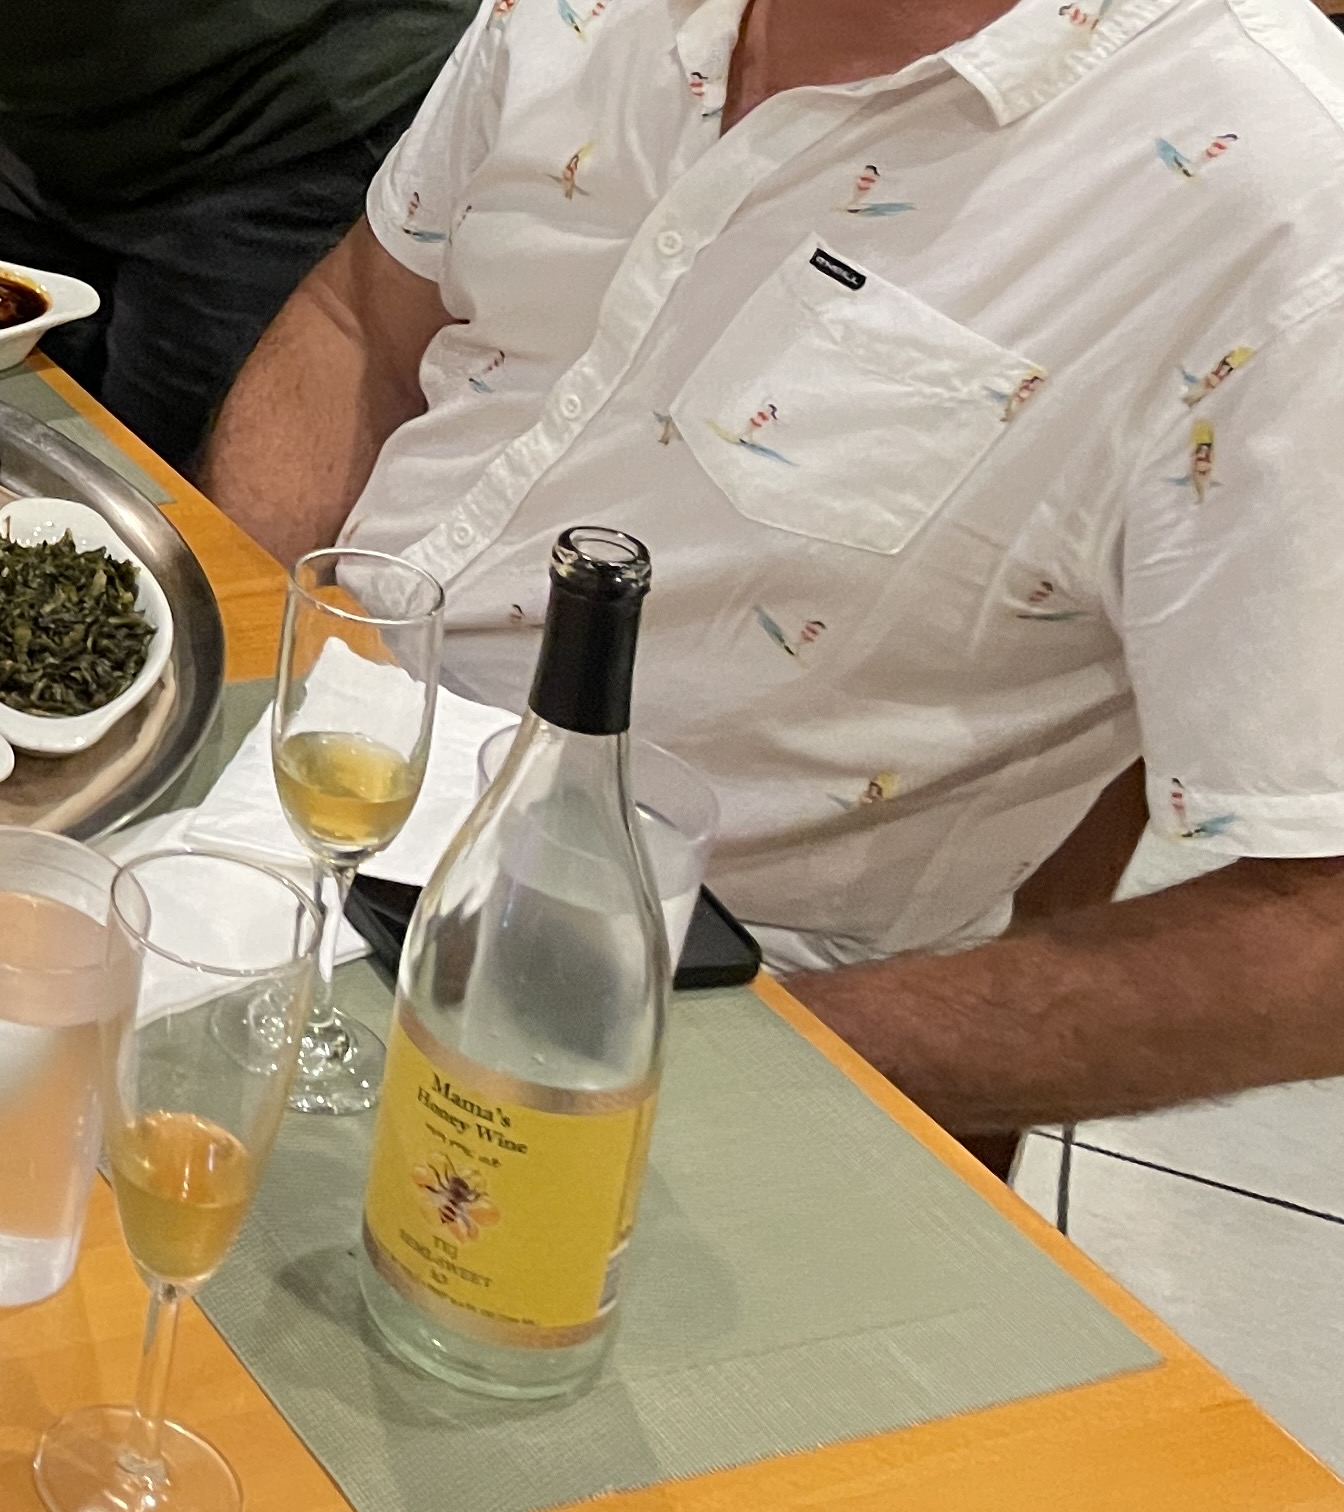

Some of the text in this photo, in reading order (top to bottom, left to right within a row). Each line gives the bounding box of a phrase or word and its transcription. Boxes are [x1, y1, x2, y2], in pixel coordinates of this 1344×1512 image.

[418, 1085, 471, 1134] Honey
[476, 1123, 528, 1154] Wine
[431, 1072, 511, 1128] Mama's
